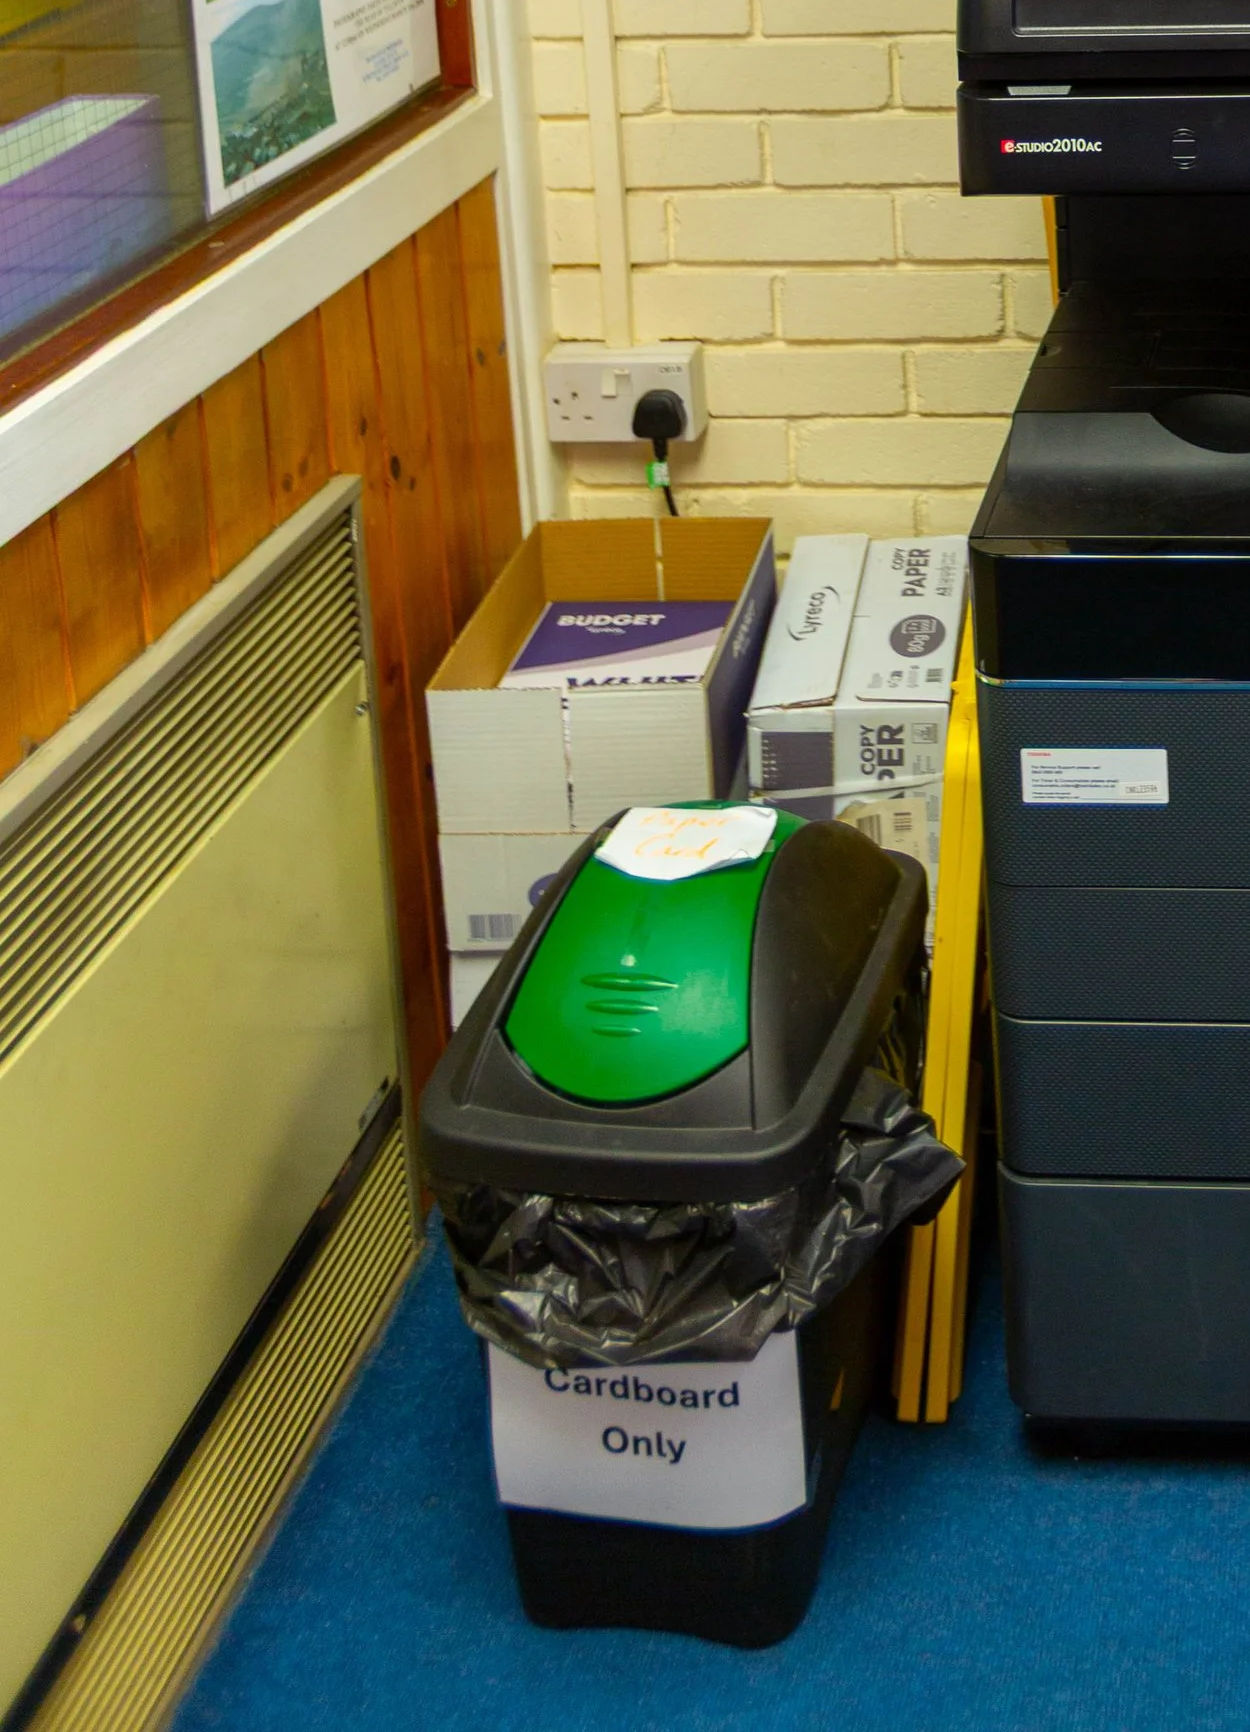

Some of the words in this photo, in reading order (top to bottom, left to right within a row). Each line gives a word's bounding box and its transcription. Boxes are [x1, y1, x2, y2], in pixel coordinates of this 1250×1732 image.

[891, 548, 907, 571] COPY
[902, 548, 931, 597] PAPER
[557, 614, 666, 627] BUDGET
[801, 591, 827, 635] Lyreco
[908, 633, 930, 653] 80g
[860, 724, 876, 775] COPY
[544, 1368, 740, 1409] Cardboard
[602, 1426, 686, 1464] Only
